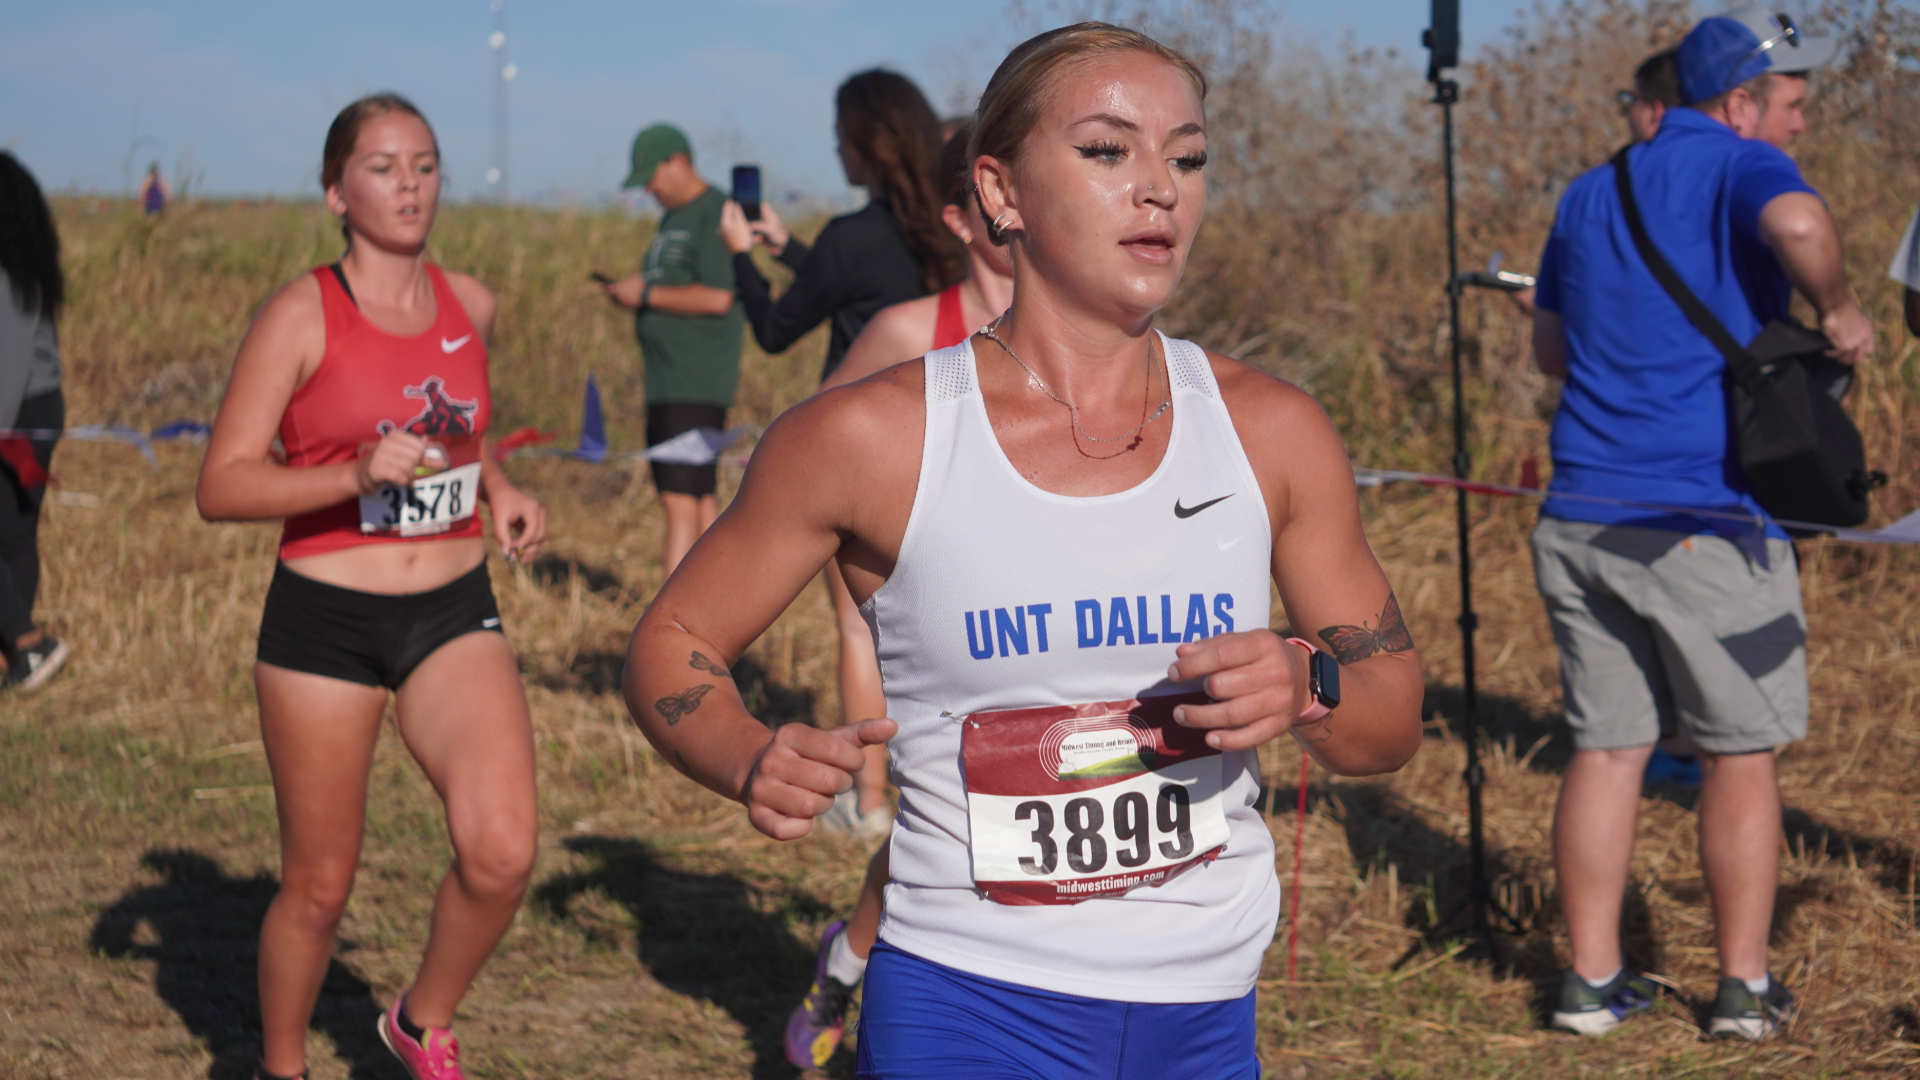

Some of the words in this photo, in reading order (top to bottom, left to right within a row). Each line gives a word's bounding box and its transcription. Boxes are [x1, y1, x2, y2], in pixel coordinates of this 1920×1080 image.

[382, 480, 462, 525] 3578
[965, 603, 1052, 660] UNT
[1075, 593, 1234, 648] DALLAS
[1061, 743, 1084, 751] Midwest
[1085, 741, 1104, 750] Timing
[1105, 739, 1116, 747] and
[1117, 737, 1136, 745] Results
[1014, 784, 1195, 876] 3899
